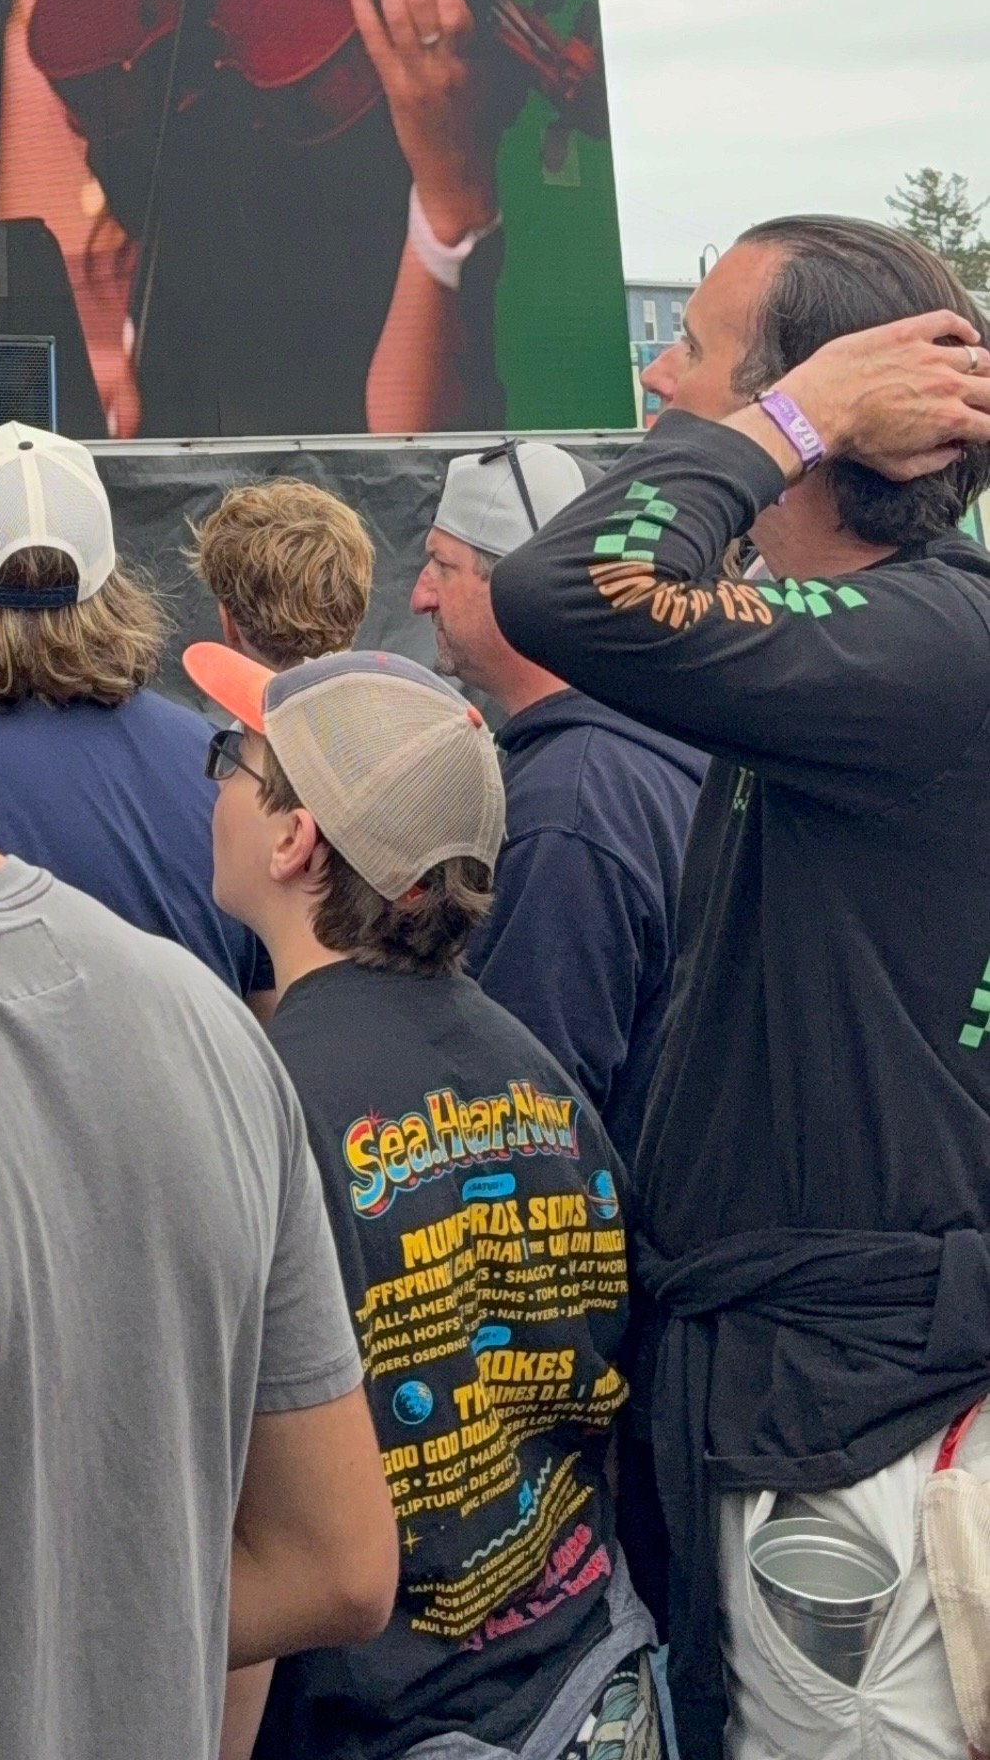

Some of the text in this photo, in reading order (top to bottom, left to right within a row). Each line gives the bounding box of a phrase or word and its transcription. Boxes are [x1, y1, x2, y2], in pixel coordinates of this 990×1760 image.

[528, 1194, 587, 1231] SONS
[476, 1239, 522, 1263] KHAN
[570, 1231, 591, 1253] ON
[577, 1260, 596, 1274] AT
[597, 1258, 627, 1275] WOR
[535, 1285, 558, 1302] TOM
[597, 1280, 629, 1294] ULTR
[497, 1308, 523, 1320] NAT
[477, 1349, 575, 1383] ROKES
[423, 1430, 460, 1465] GOO
[425, 1456, 468, 1488] ZIGGY
[394, 1486, 464, 1520] FLIPTURN
[469, 1470, 489, 1491] DIE
